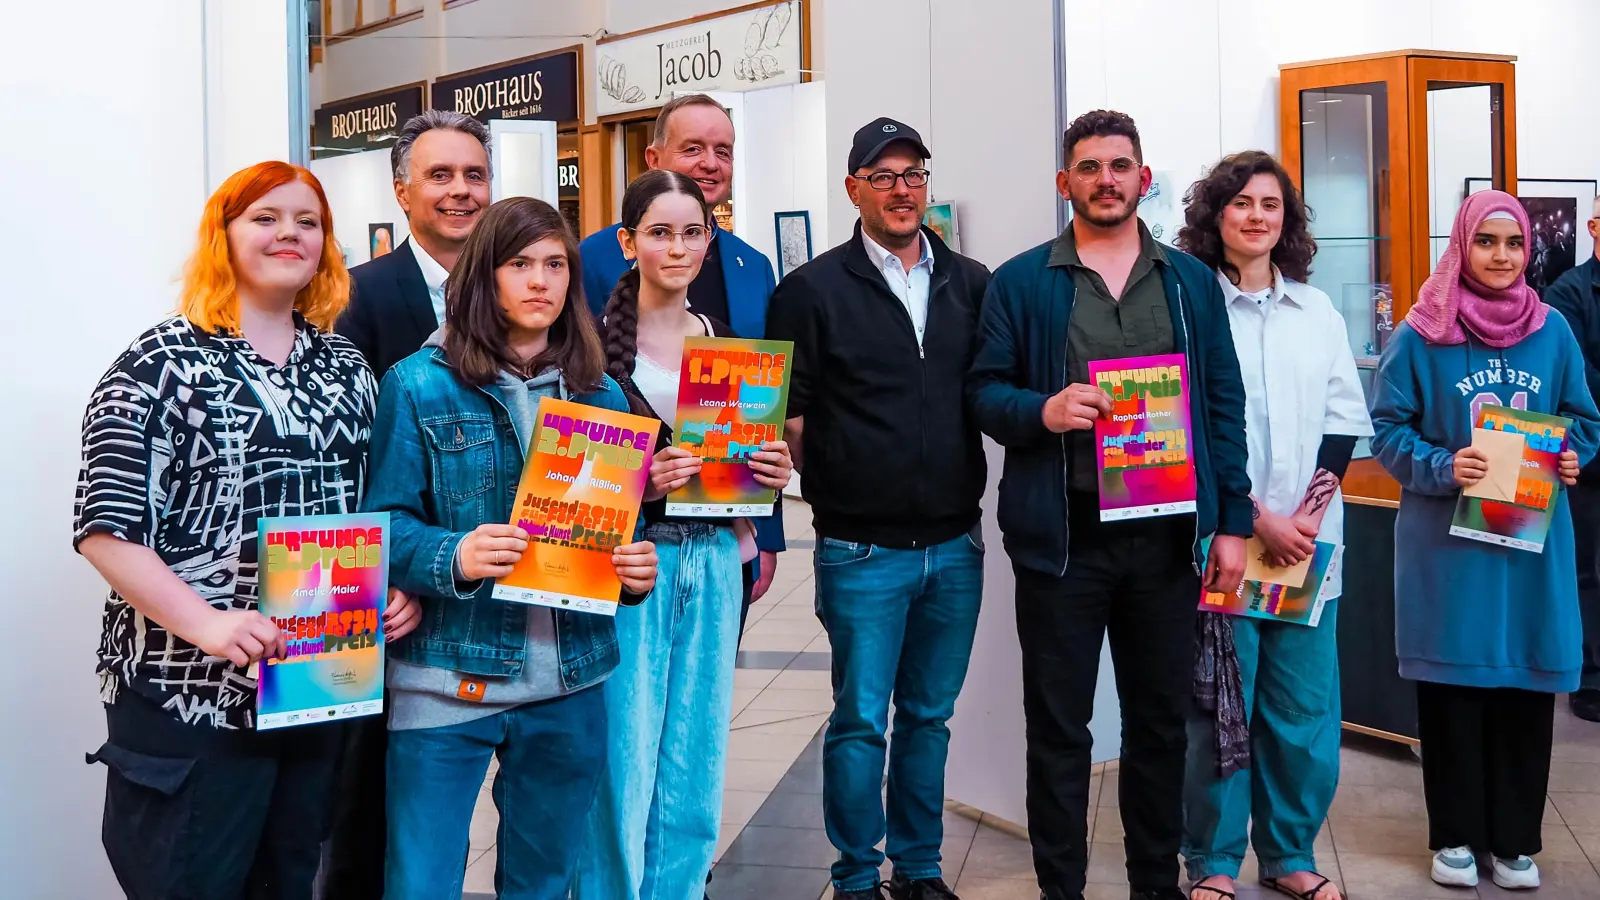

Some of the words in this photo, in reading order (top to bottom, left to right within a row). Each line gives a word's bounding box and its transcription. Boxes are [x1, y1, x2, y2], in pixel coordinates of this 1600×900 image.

[666, 34, 705, 49] METZGEREI
[655, 31, 721, 99] Jacob
[454, 71, 543, 116] BROTHAUS
[502, 108, 518, 119] Bäcker
[519, 106, 529, 116] seit
[529, 104, 542, 114] 1616
[332, 102, 397, 139] BROTHAUS
[1455, 368, 1541, 396] NUMBER
[699, 398, 726, 408] Leana
[728, 400, 766, 409] Werwein
[1112, 412, 1145, 423] Raphael
[1146, 410, 1172, 419] Rother
[523, 493, 579, 514] Jugend
[549, 525, 572, 540] Kunst
[329, 584, 360, 595] Maier
[301, 640, 325, 655] Kunst
